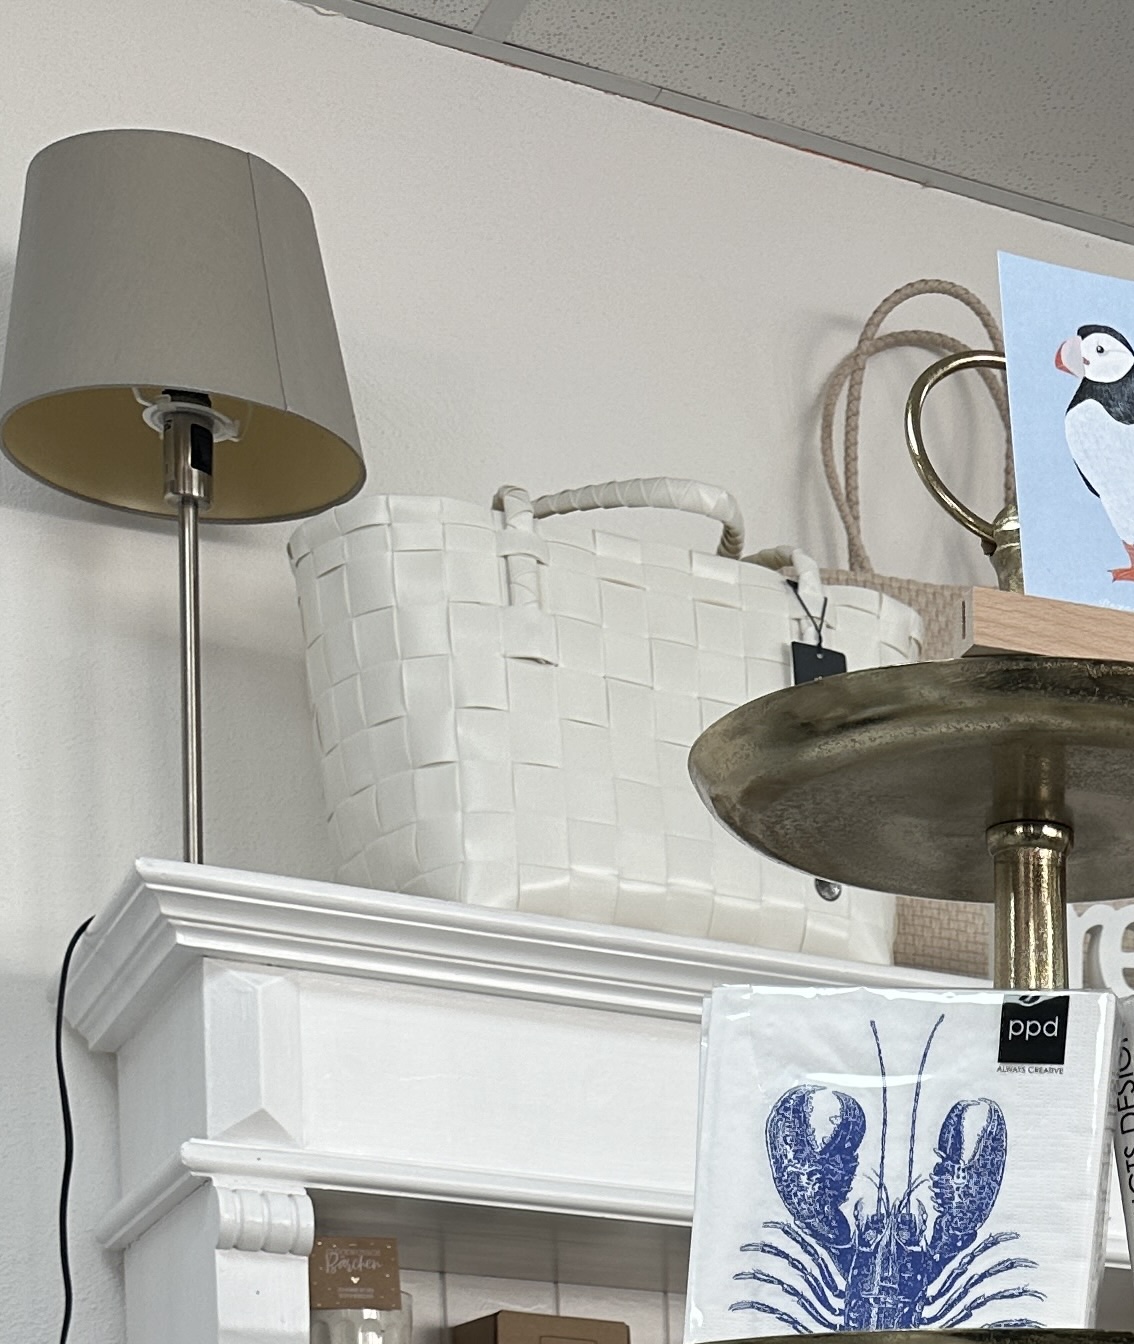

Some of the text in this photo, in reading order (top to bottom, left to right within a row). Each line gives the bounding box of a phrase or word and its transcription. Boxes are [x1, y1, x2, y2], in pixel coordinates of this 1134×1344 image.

[1008, 1015, 1059, 1041] ppd
[996, 1065, 1064, 1075] ALWAYS CREATIVE
